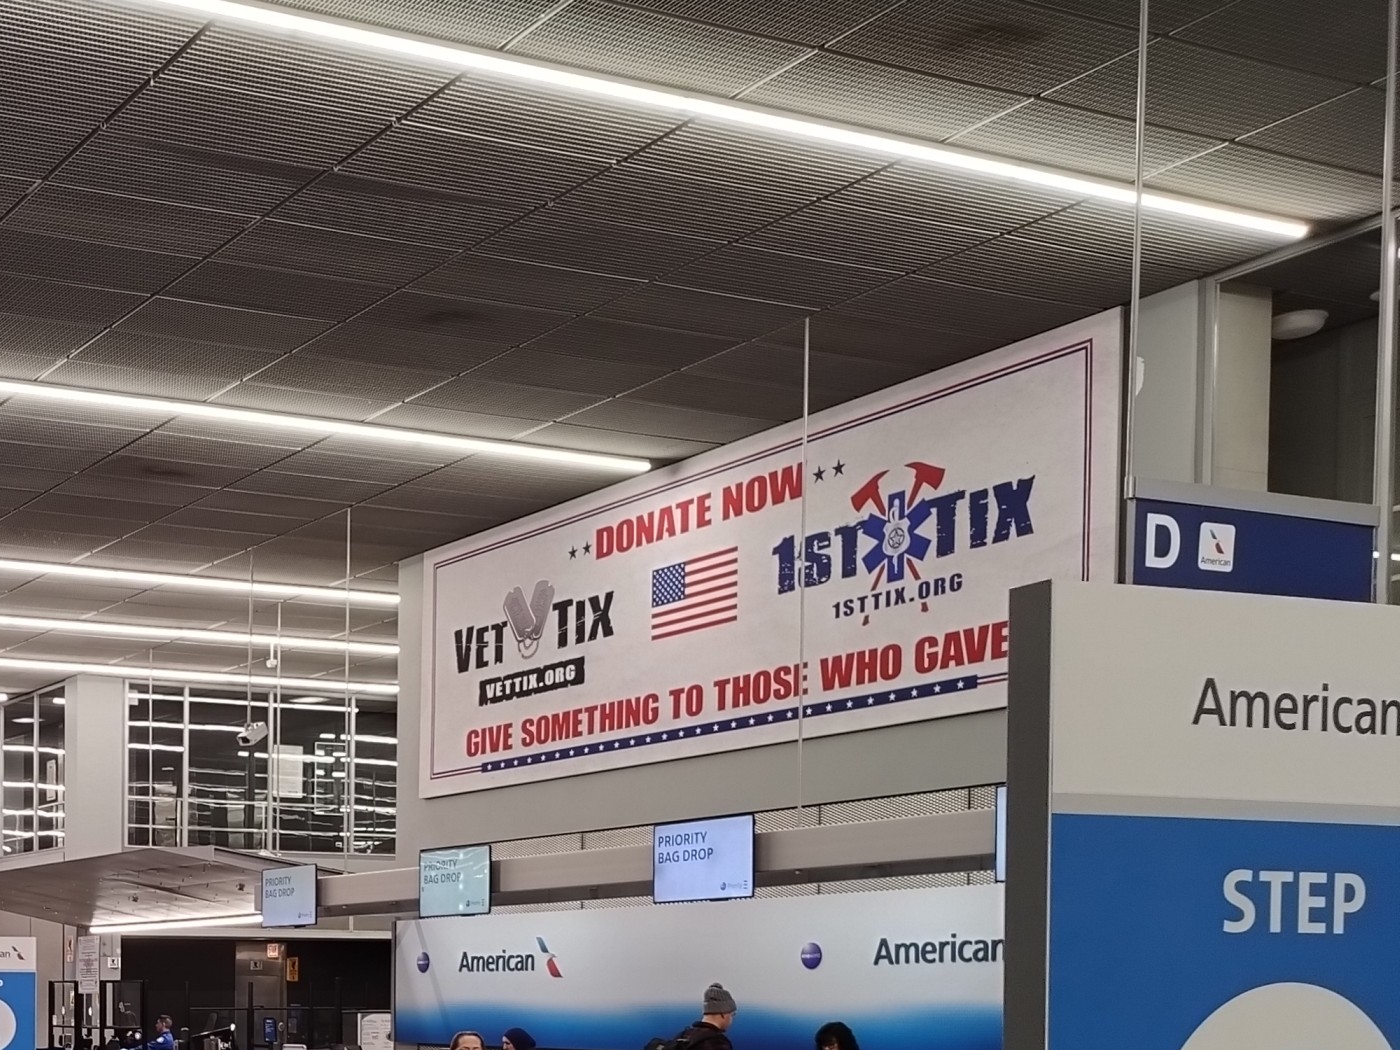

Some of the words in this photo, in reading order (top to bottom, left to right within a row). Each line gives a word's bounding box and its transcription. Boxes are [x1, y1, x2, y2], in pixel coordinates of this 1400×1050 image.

[596, 492, 711, 560] DONATE
[722, 462, 803, 521] NOW
[772, 521, 862, 594] 1ST
[927, 474, 1035, 558] TIX
[1145, 512, 1181, 569] D
[1200, 556, 1231, 567] American
[832, 573, 963, 619] 1STTIX.ORG
[454, 621, 508, 673] VET
[552, 590, 614, 650] TIX
[466, 722, 513, 757] GIVE
[521, 693, 659, 747] SOMETHING
[669, 684, 704, 719] TO
[713, 662, 808, 711] THOSE
[820, 644, 902, 691] WHO
[914, 620, 1008, 674] GAVE
[485, 664, 577, 699] VETTIX.ORG
[1191, 677, 1400, 737] American
[658, 831, 707, 848] PRIORITY
[658, 851, 680, 864] BAG
[682, 847, 714, 861] DROP
[265, 876, 291, 887] PRIORITY
[424, 859, 458, 871] PRIORITY
[424, 874, 439, 884] BAG
[441, 872, 461, 883] DROP
[265, 889, 277, 898] BAG
[278, 887, 295, 897] DROP
[1222, 869, 1367, 935] STEP
[458, 949, 535, 973] American
[873, 933, 1004, 966] American
